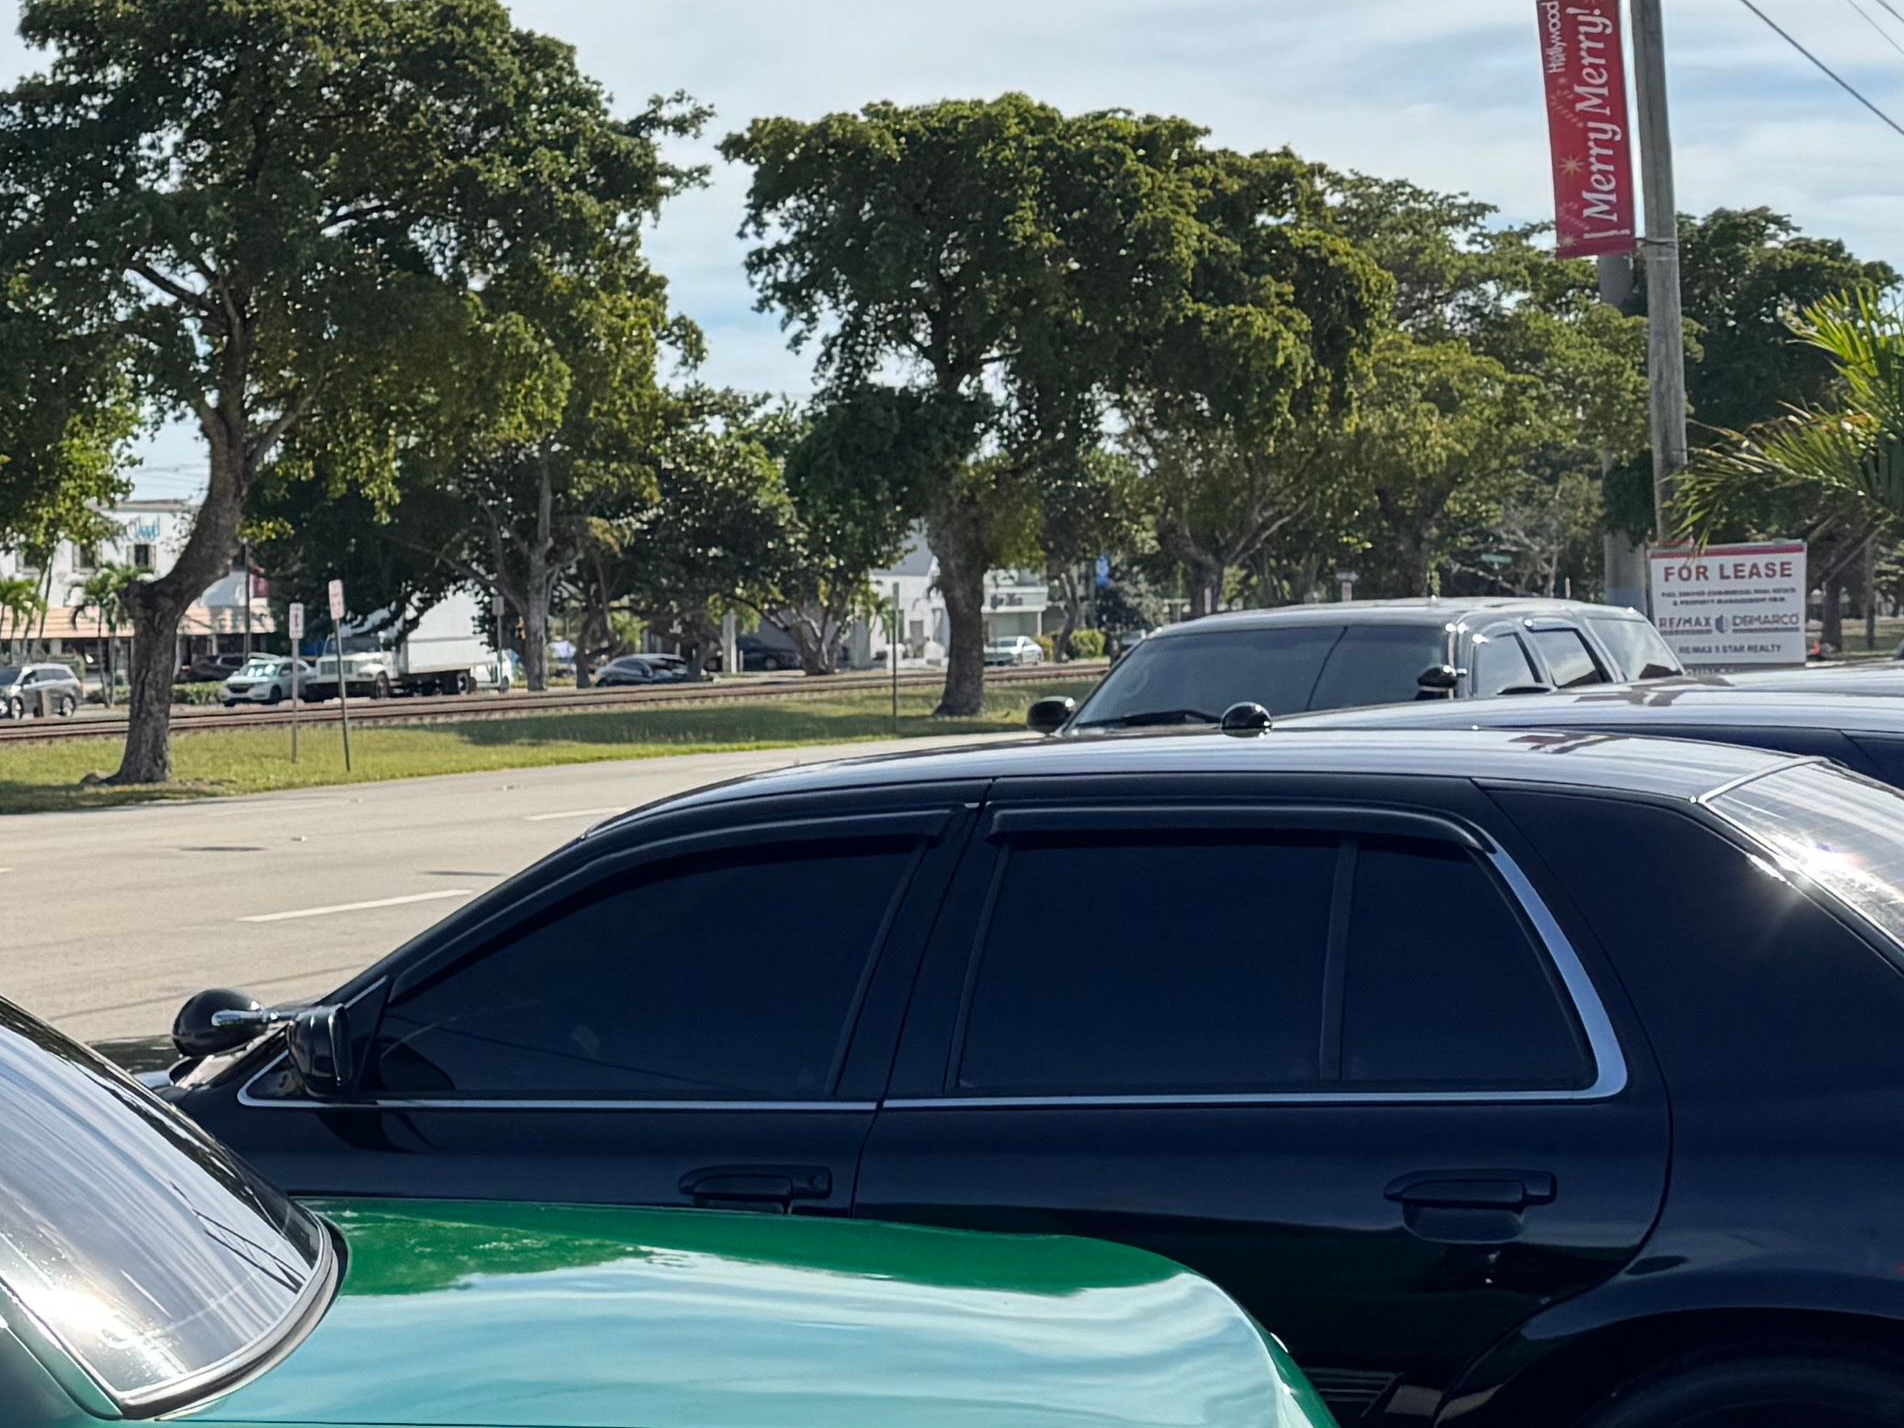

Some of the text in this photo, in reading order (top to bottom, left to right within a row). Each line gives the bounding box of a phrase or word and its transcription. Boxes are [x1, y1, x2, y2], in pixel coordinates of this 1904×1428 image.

[1541, 1, 1567, 73] Hollywood
[1566, 7, 1613, 116] Merry!
[1582, 122, 1622, 222] Merry
[1664, 561, 1793, 583] FOR LEASE
[1659, 616, 1712, 629] RE/MAX
[1747, 642, 1782, 653] REALTY
